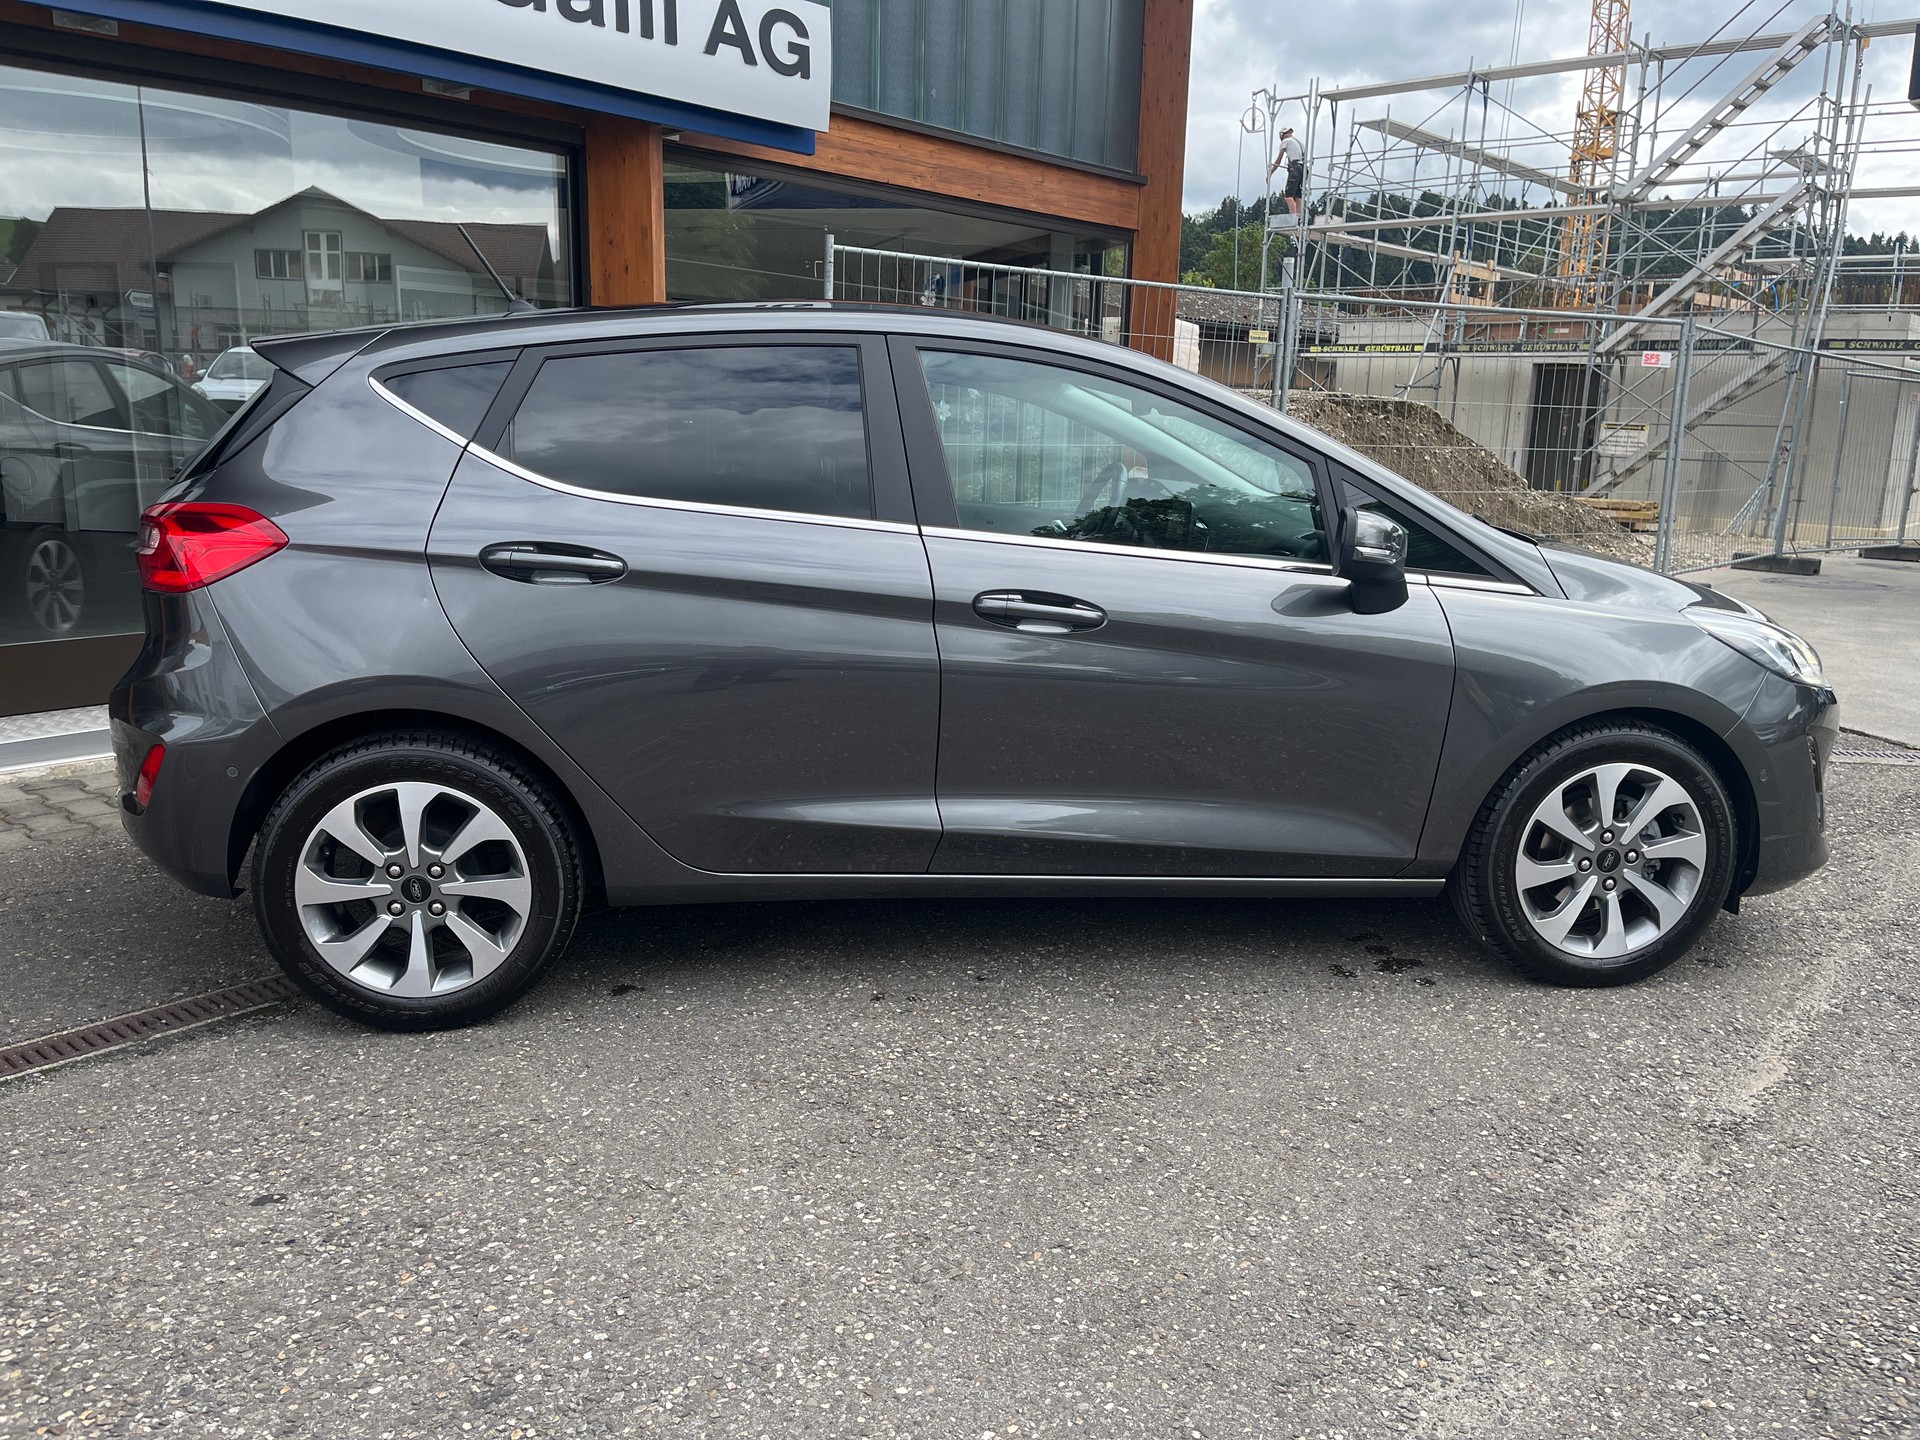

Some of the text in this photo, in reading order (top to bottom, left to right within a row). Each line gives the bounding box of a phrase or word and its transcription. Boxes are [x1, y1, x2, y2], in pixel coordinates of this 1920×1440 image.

[702, 0, 811, 80] AG
[1322, 344, 1412, 353] SCHWARZ GERÜSTBAU
[1472, 344, 1514, 352] SCHWARZ
[1848, 340, 1905, 349] SCHWARZ
[1644, 353, 1661, 363] SFS
